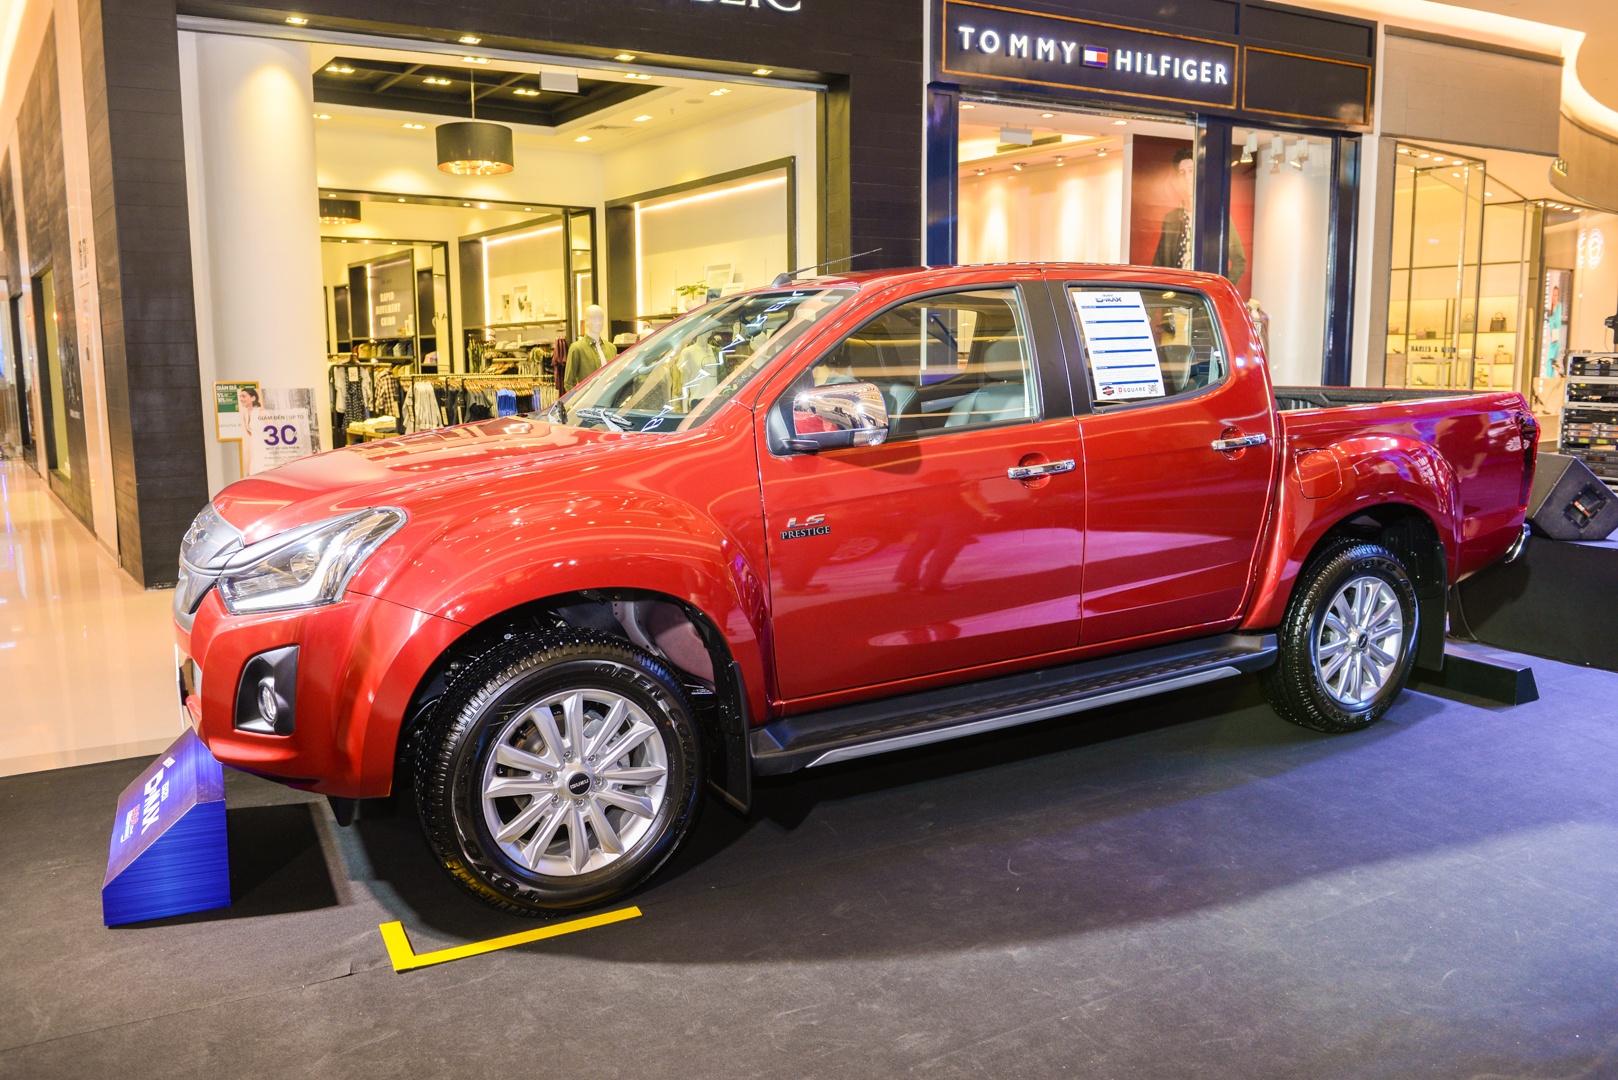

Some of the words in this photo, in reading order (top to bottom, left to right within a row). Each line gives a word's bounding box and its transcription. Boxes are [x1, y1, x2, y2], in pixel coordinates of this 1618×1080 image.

[958, 26, 1077, 64] TOMMY
[1115, 49, 1229, 85] HILFIGER
[263, 424, 298, 446] 30
[787, 513, 826, 529] LS
[781, 525, 831, 540] PRESTIGE
[594, 664, 668, 701] OPEN
[569, 779, 589, 789] ISUZU
